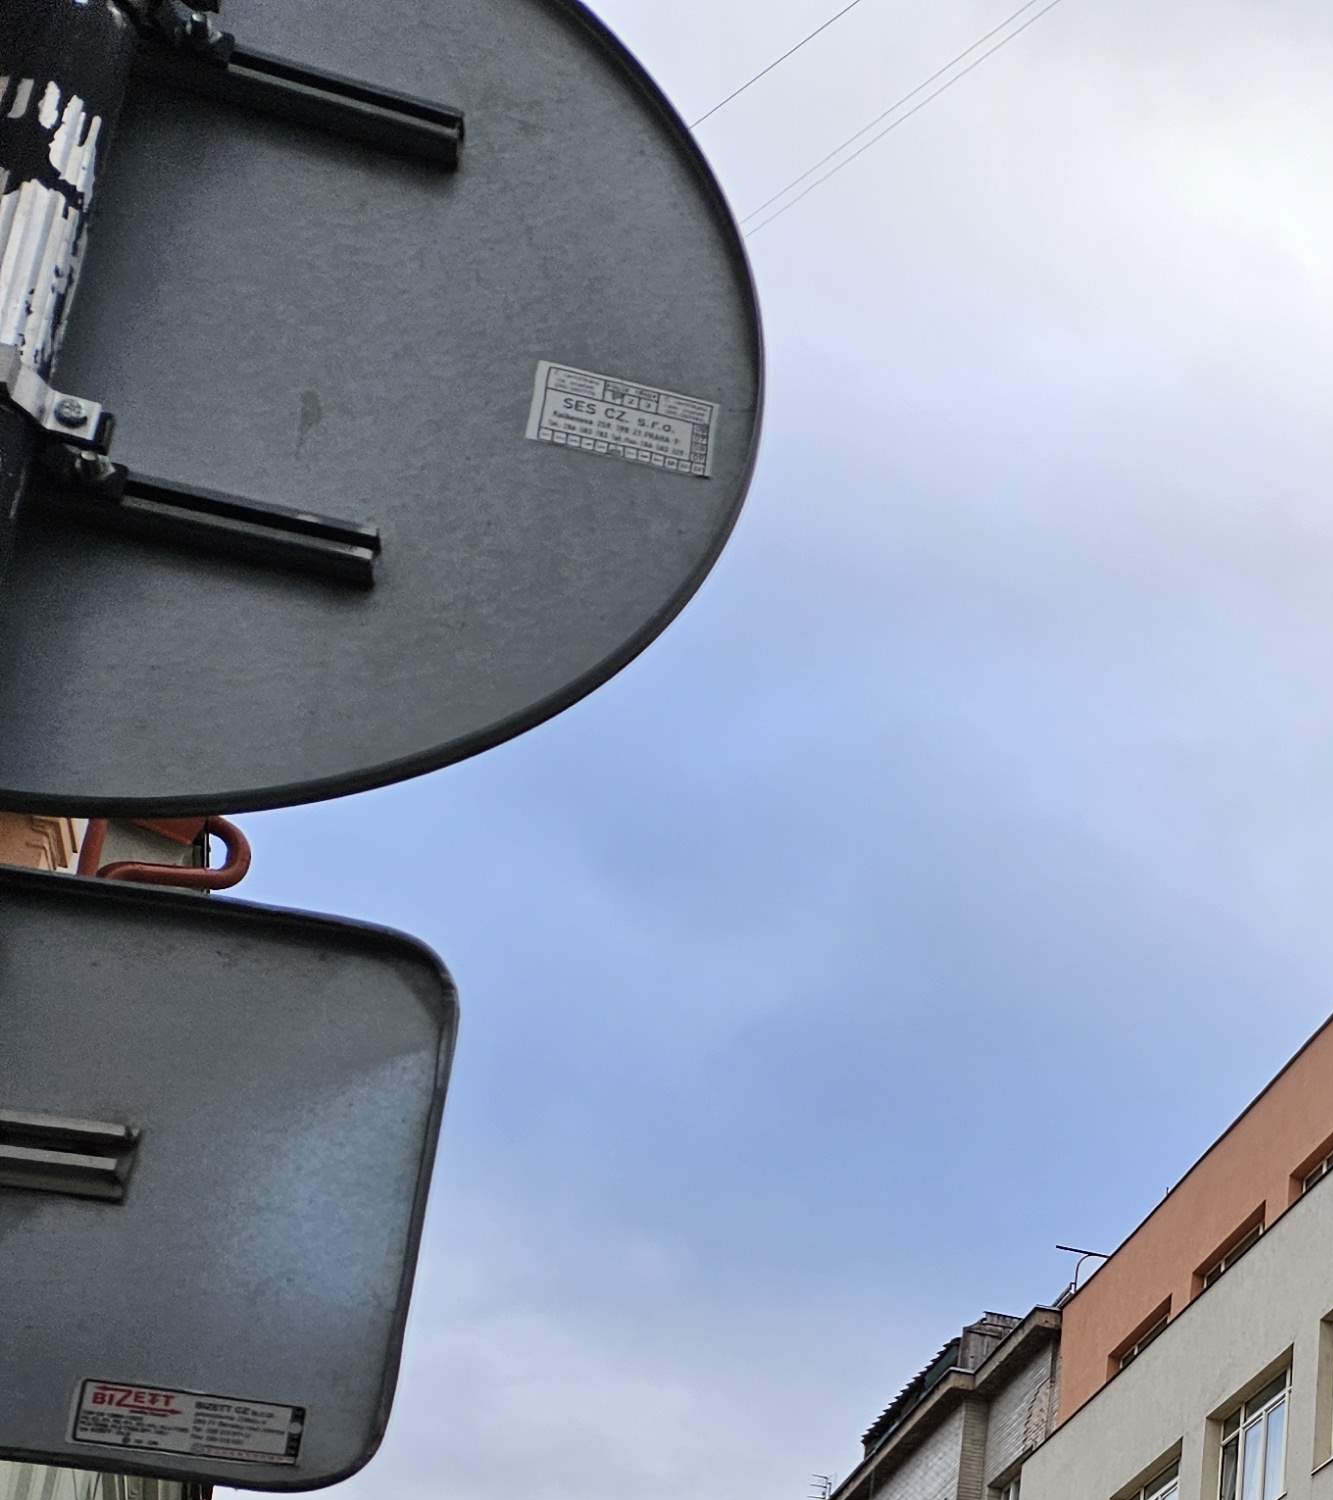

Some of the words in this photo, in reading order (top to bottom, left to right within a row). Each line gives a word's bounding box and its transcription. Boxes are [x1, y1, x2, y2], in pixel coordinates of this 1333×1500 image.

[563, 397, 596, 415] SES
[637, 417, 676, 434] s.r.o.
[92, 1387, 177, 1409] BIZETT
